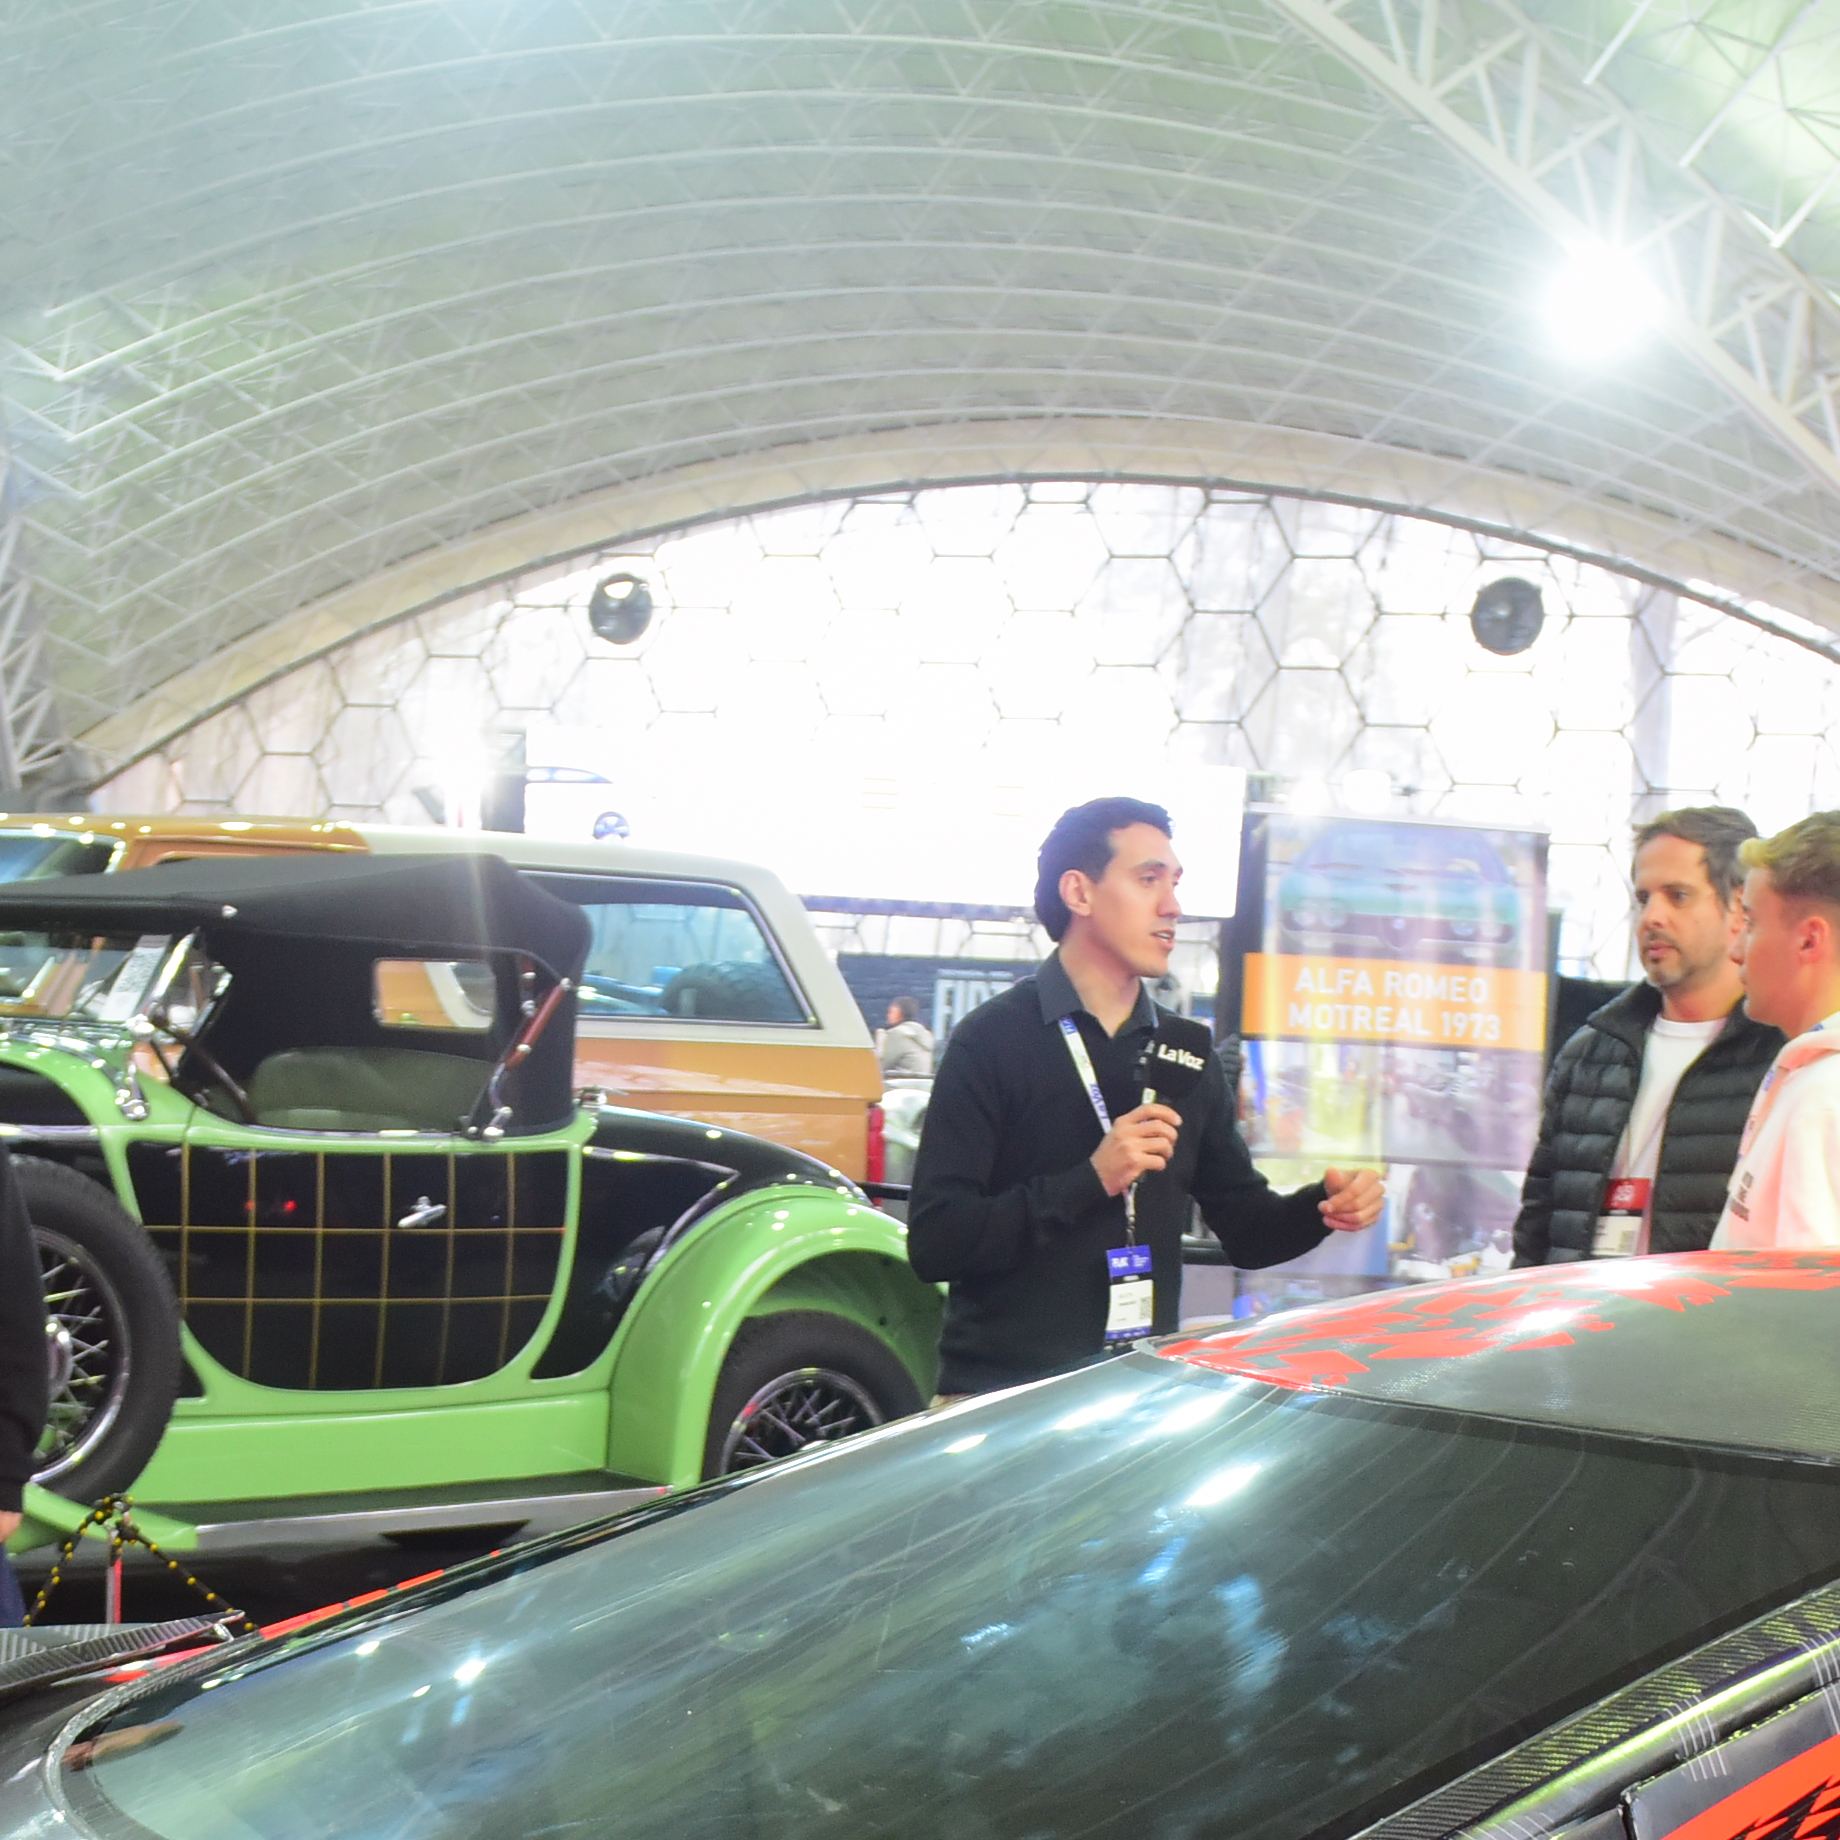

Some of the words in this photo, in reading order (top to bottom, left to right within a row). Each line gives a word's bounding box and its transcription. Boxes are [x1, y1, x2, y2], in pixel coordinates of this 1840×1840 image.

[1294, 967, 1374, 997] ALFA
[1384, 971, 1489, 1005] ROMEO
[1288, 1001, 1433, 1037] MOTREAL
[1440, 1011, 1501, 1042] 1973
